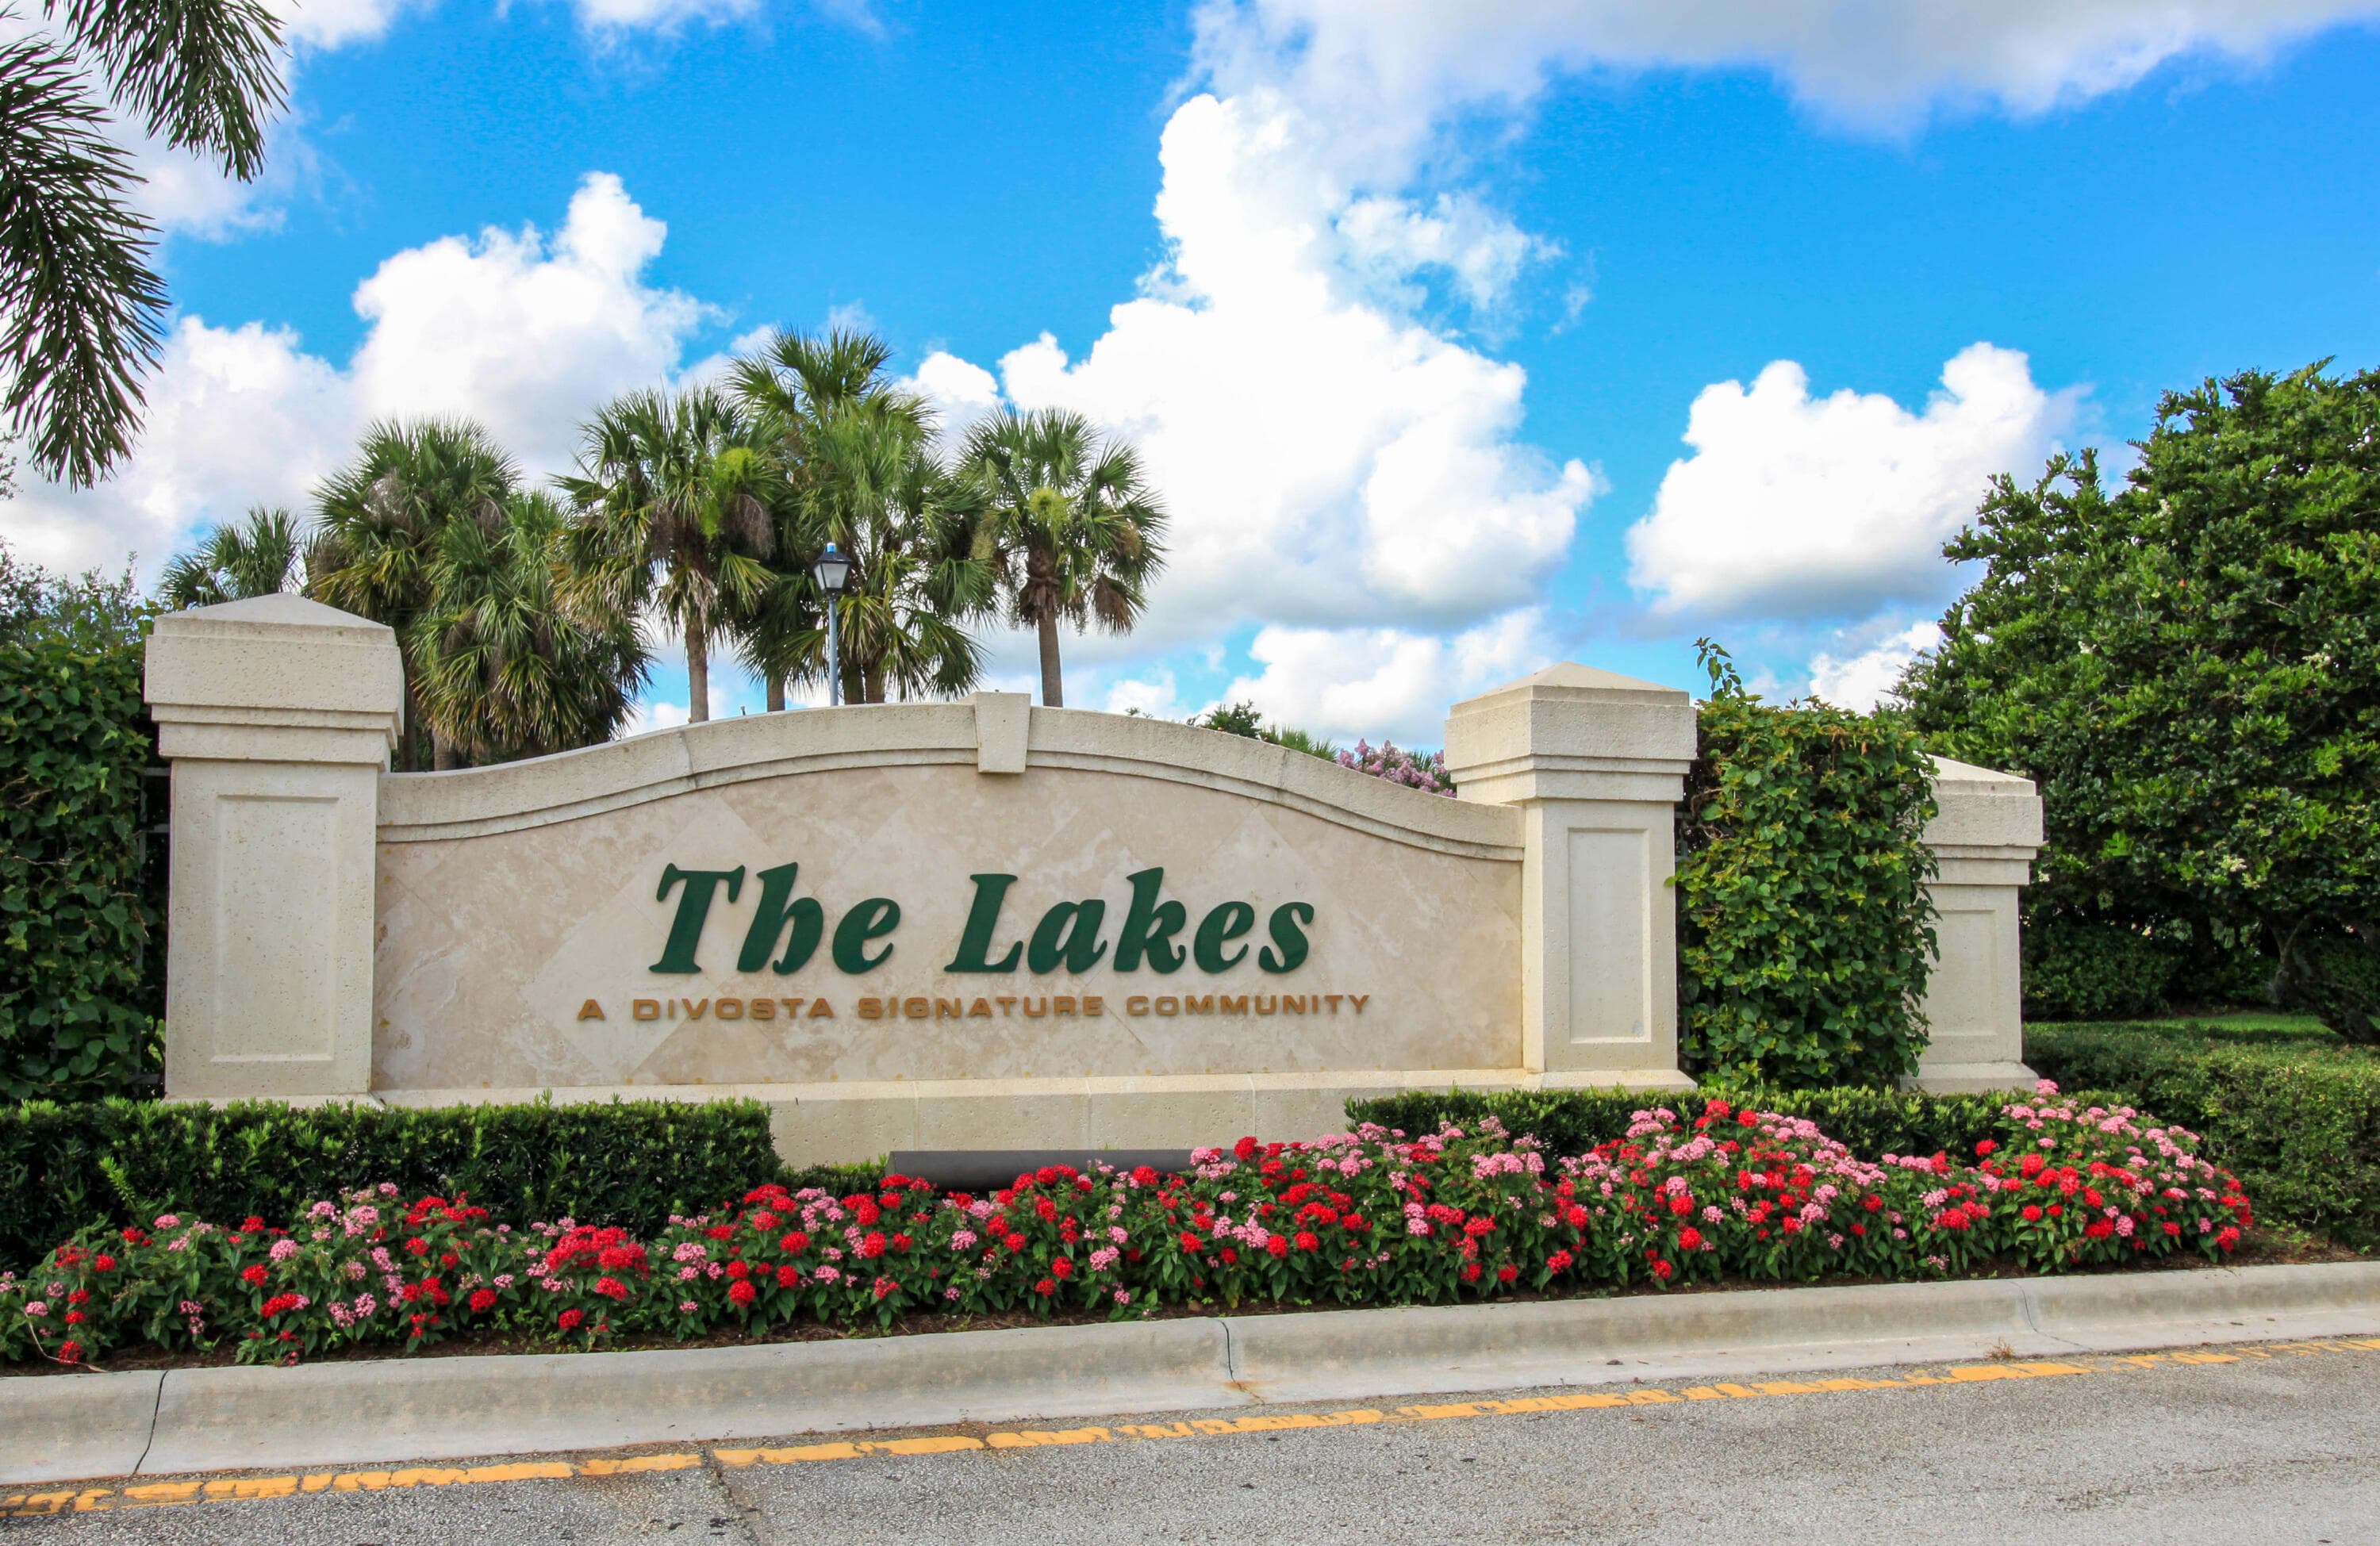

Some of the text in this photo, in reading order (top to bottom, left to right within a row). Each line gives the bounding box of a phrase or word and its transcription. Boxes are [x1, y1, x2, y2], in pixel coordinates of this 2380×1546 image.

[648, 862, 1316, 976] The Lakes
[577, 994, 1370, 1021] A DIVOSTA SIGNATURE COMMUNITY
